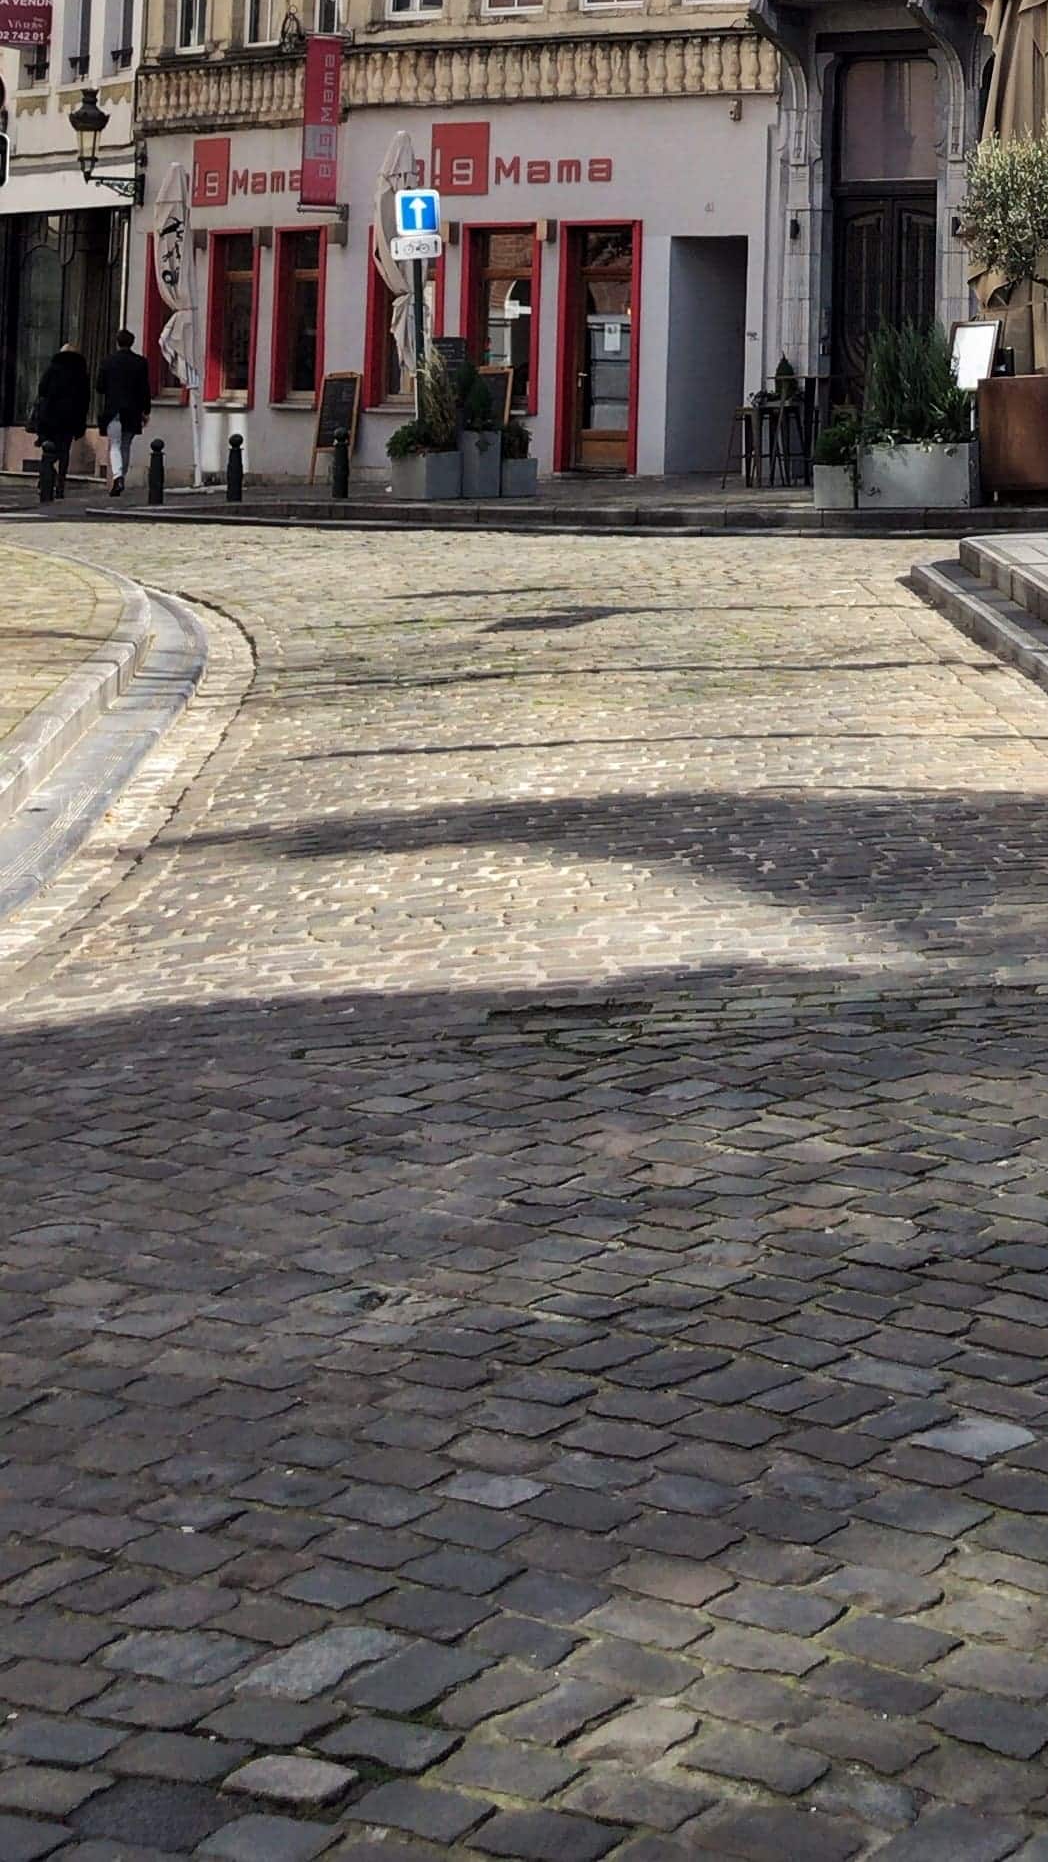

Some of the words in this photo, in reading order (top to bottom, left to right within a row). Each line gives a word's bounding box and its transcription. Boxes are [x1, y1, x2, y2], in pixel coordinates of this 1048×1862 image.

[12, 32, 30, 40] 742
[321, 54, 336, 122] Mama
[231, 167, 301, 196] Mama
[494, 155, 613, 186] Mama
